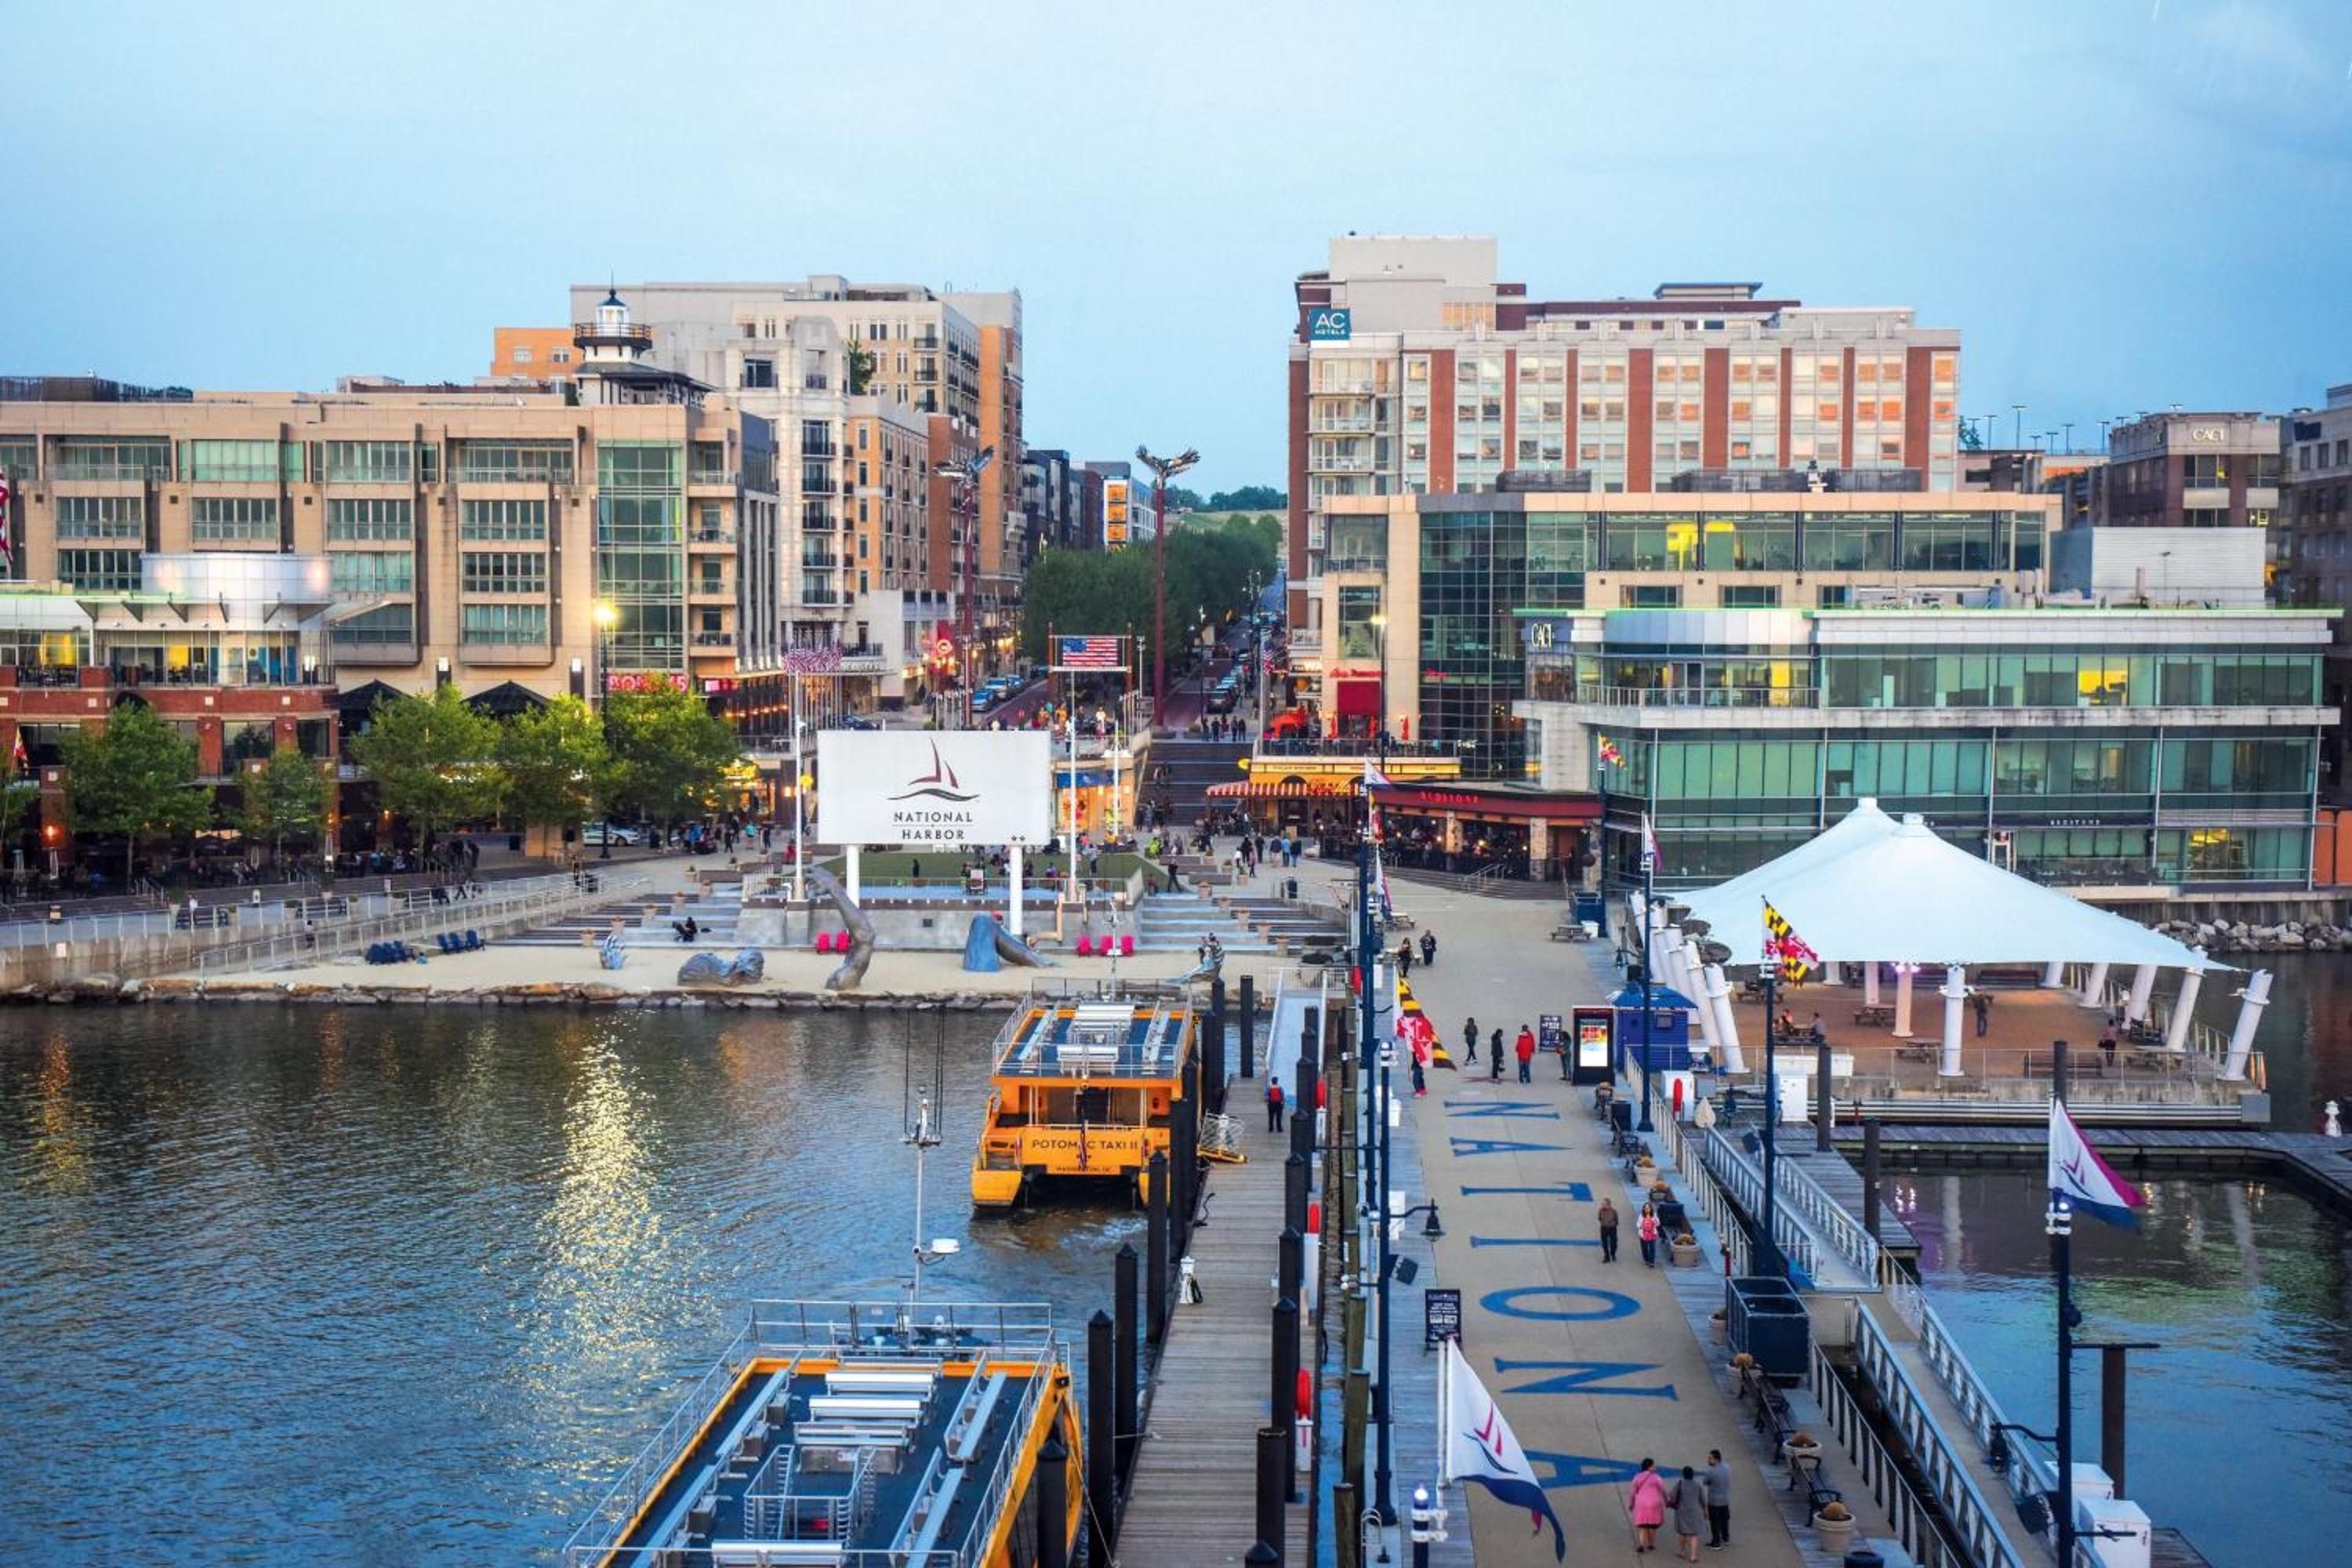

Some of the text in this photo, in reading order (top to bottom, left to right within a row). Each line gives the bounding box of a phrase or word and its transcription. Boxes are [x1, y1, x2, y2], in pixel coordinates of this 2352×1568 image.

[1316, 313, 1345, 328] AC
[2193, 427, 2224, 441] CACI
[894, 811, 972, 822] NATIONAL
[902, 829, 964, 840] HARBOR
[1031, 1139, 1096, 1149] POTOMC
[1101, 1140, 1127, 1149] TAXI
